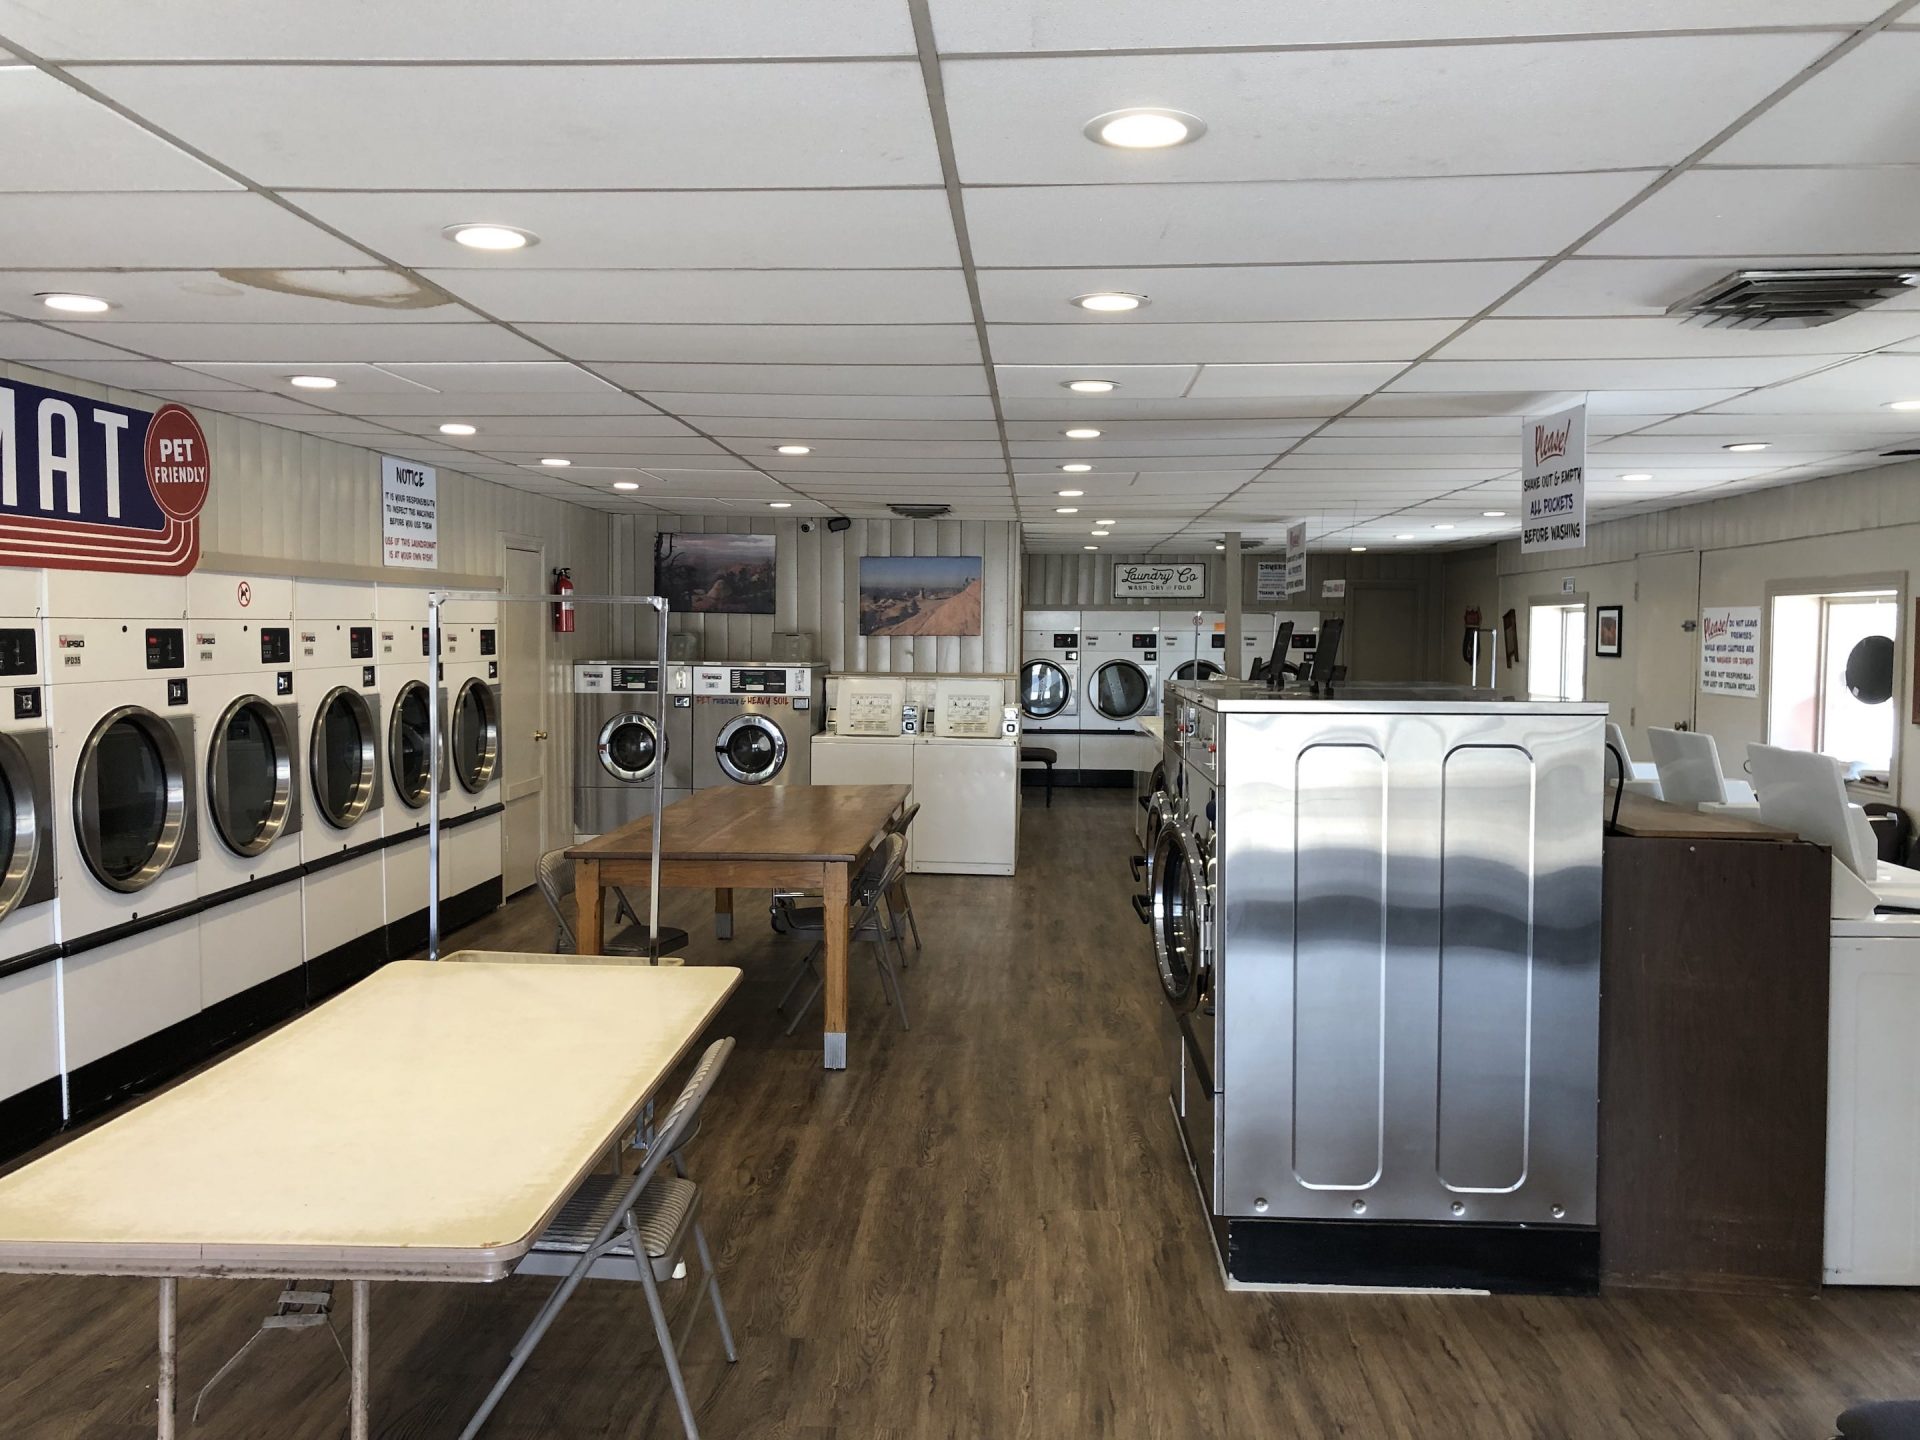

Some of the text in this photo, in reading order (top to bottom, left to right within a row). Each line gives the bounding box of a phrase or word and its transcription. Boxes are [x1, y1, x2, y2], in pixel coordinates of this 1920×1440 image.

[159, 438, 194, 463] PET
[1535, 418, 1571, 468] Please!
[154, 466, 205, 484] FRIENDLY
[396, 466, 425, 488] NOTICE
[1523, 467, 1582, 492] SHAKE OUT & EMPTY
[395, 494, 406, 504] YOUR
[406, 495, 436, 508] RESPONSIBILITY
[1530, 493, 1574, 516] ALL POCKETS
[386, 504, 392, 513] TO
[393, 505, 408, 515] INSPECT
[416, 509, 435, 519] MACHINES
[389, 517, 433, 530] BEFORE YOU USE THEM
[1524, 522, 1581, 544] BEFORE WASHING
[385, 536, 437, 549] USE OF THIS LAUNDROMAT
[389, 550, 394, 559] IS
[394, 551, 400, 559] AT
[401, 551, 412, 562] YOUR
[412, 552, 422, 561] OWN
[1121, 567, 1199, 585] Laundry Co
[36, 607, 41, 618] 7
[1703, 612, 1731, 643] Please!
[66, 639, 85, 648] IPSO
[201, 637, 215, 645] IPSO
[305, 635, 316, 643] IPSO
[696, 696, 711, 705] PET
[747, 696, 771, 708] HEAVY
[773, 696, 789, 706] SOIL
